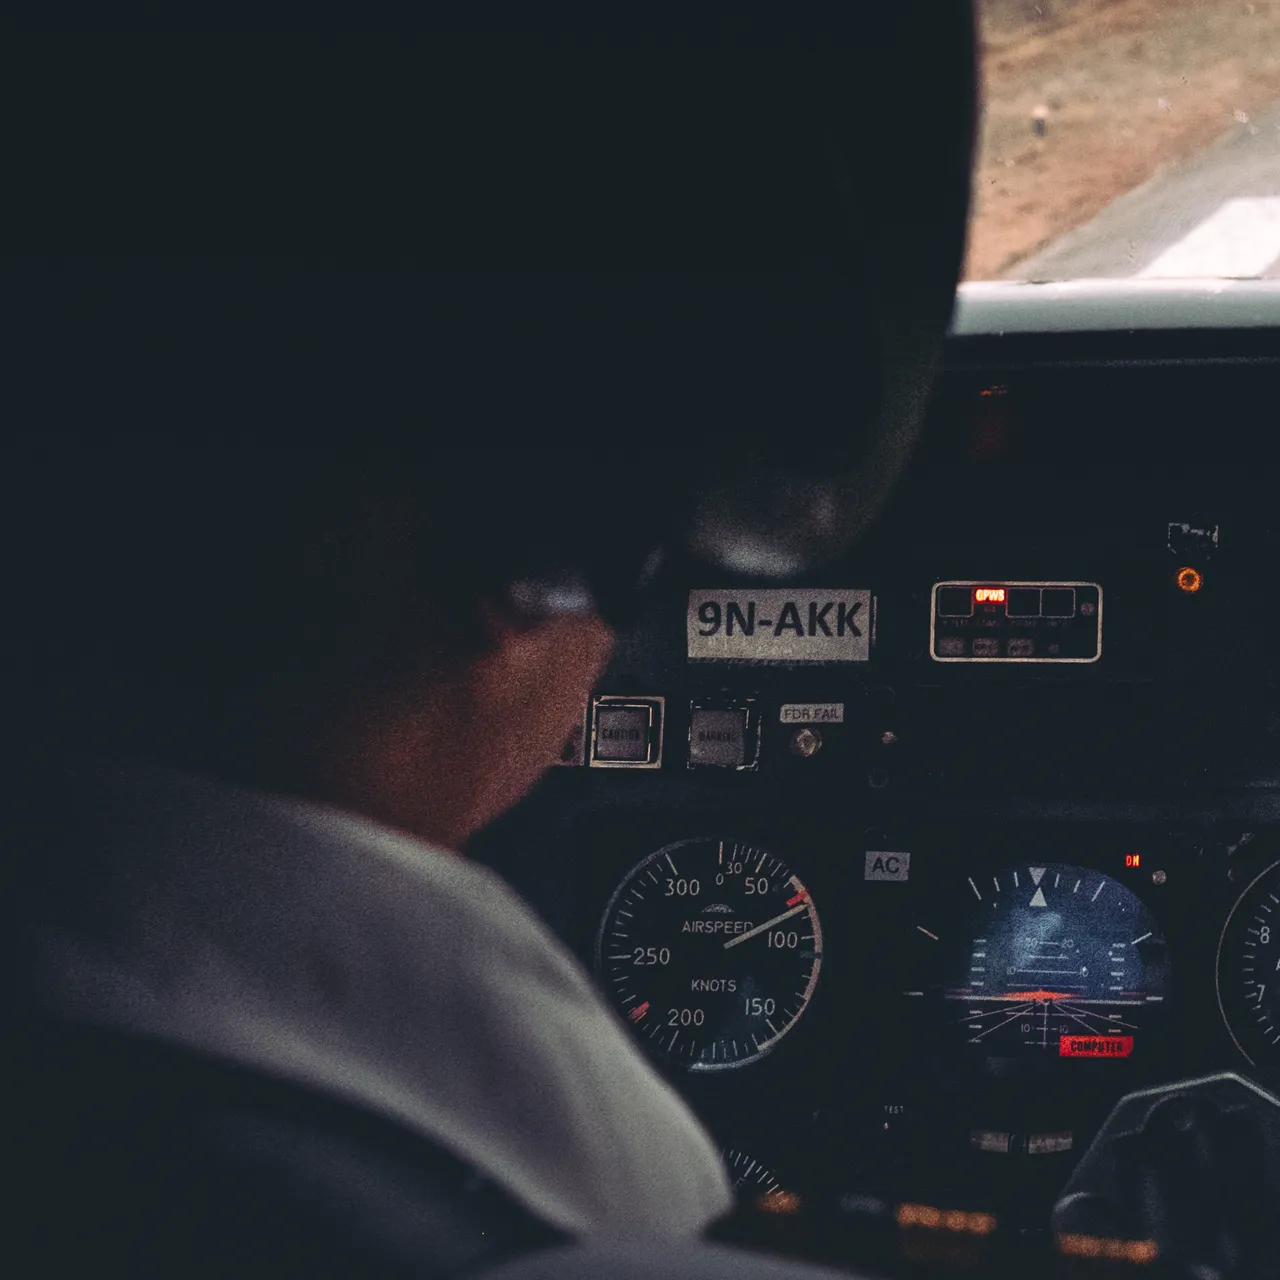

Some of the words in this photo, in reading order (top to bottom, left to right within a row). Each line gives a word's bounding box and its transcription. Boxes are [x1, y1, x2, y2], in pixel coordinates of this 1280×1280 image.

[697, 601, 863, 638] 9N-AKK
[783, 707, 811, 719] FDR
[813, 707, 839, 719] FAIL
[726, 861, 743, 875] 30
[871, 857, 901, 875] AC
[663, 878, 701, 897] 300
[743, 877, 769, 895] 50
[767, 930, 799, 950] 100
[1258, 926, 1271, 946] 8
[632, 947, 671, 966] 250
[690, 978, 738, 993] KNOTS
[1255, 983, 1267, 1003] 7
[743, 997, 776, 1017] 150
[667, 1008, 705, 1027] 200
